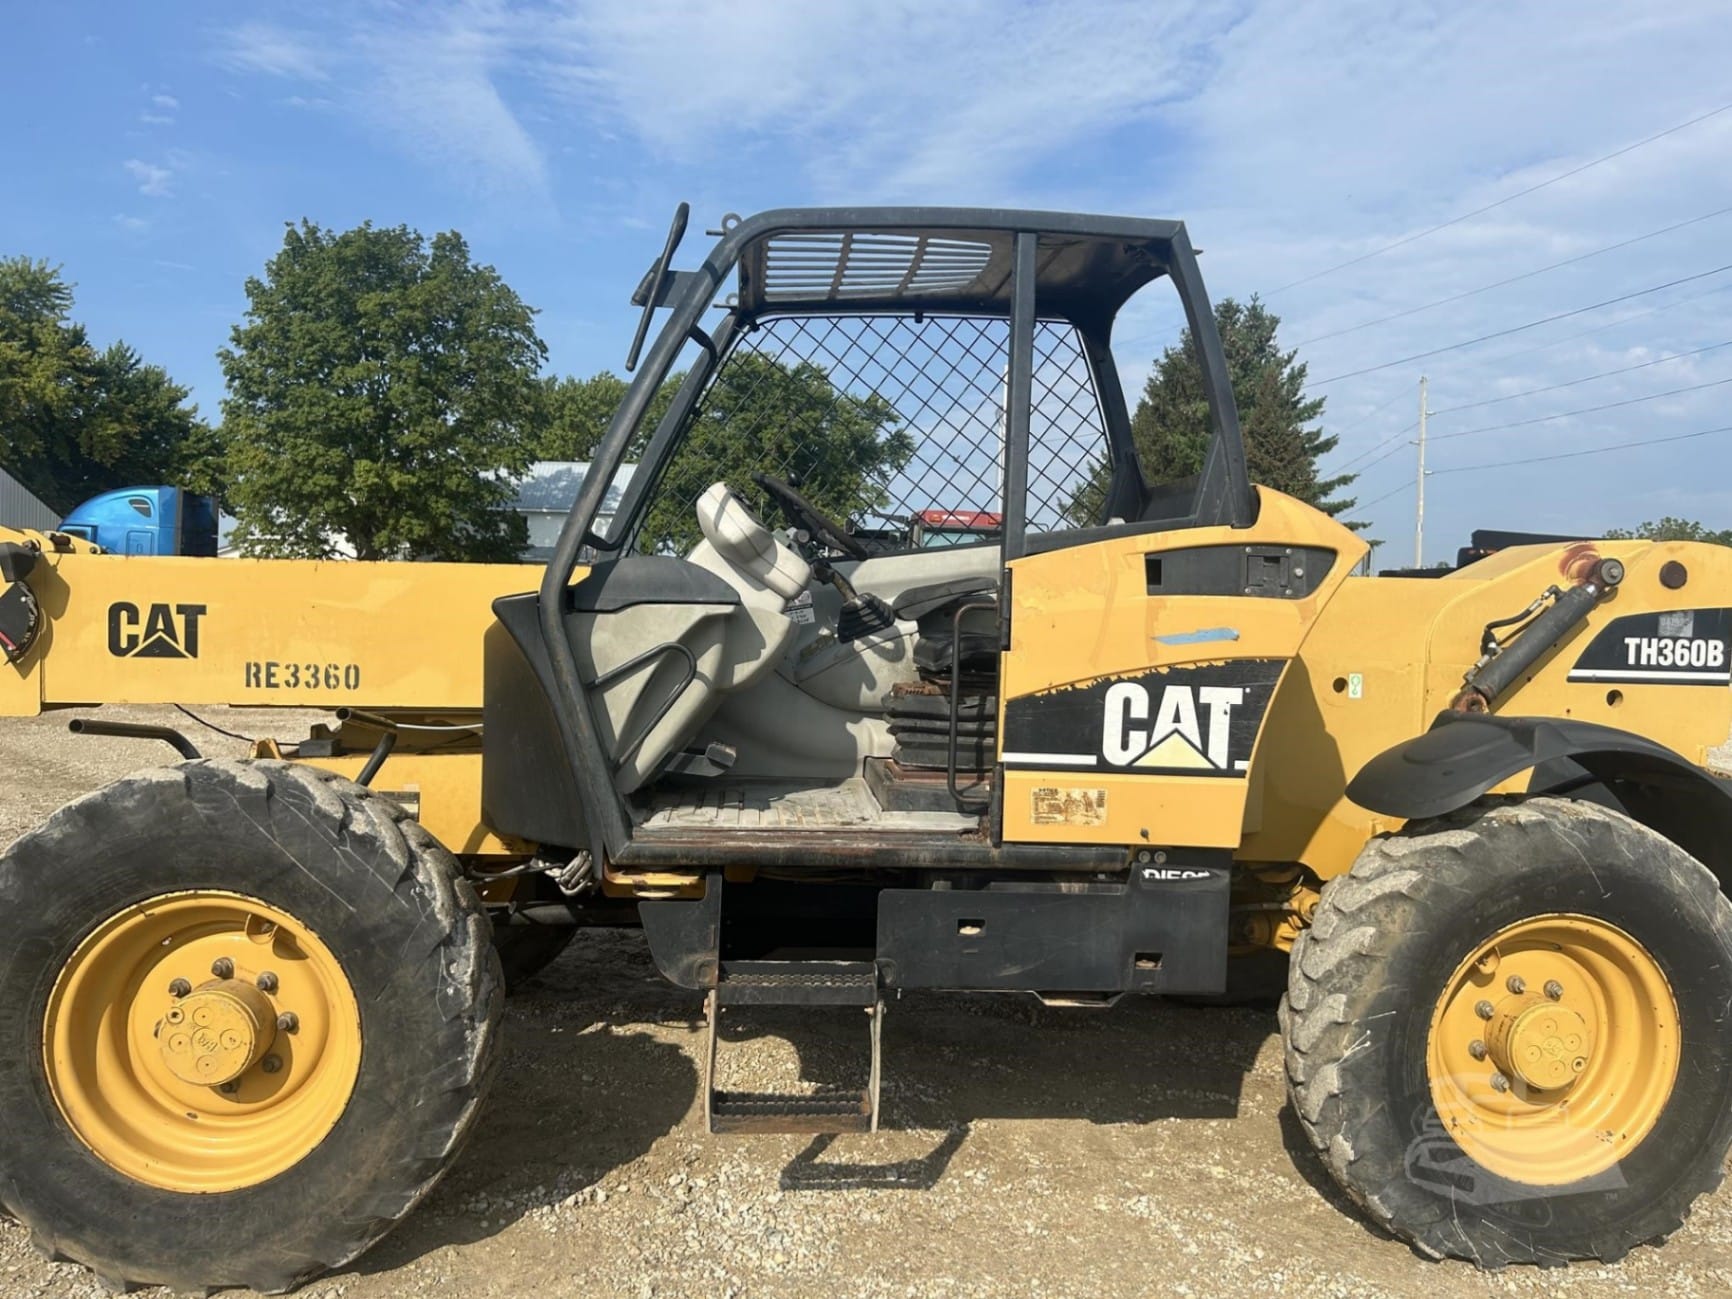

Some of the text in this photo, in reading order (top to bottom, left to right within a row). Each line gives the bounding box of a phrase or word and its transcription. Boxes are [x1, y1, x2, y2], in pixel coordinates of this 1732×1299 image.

[108, 601, 207, 658] CAT
[1624, 637, 1724, 667] TH360B
[245, 661, 360, 690] RE3360
[1102, 682, 1243, 769] CAT
